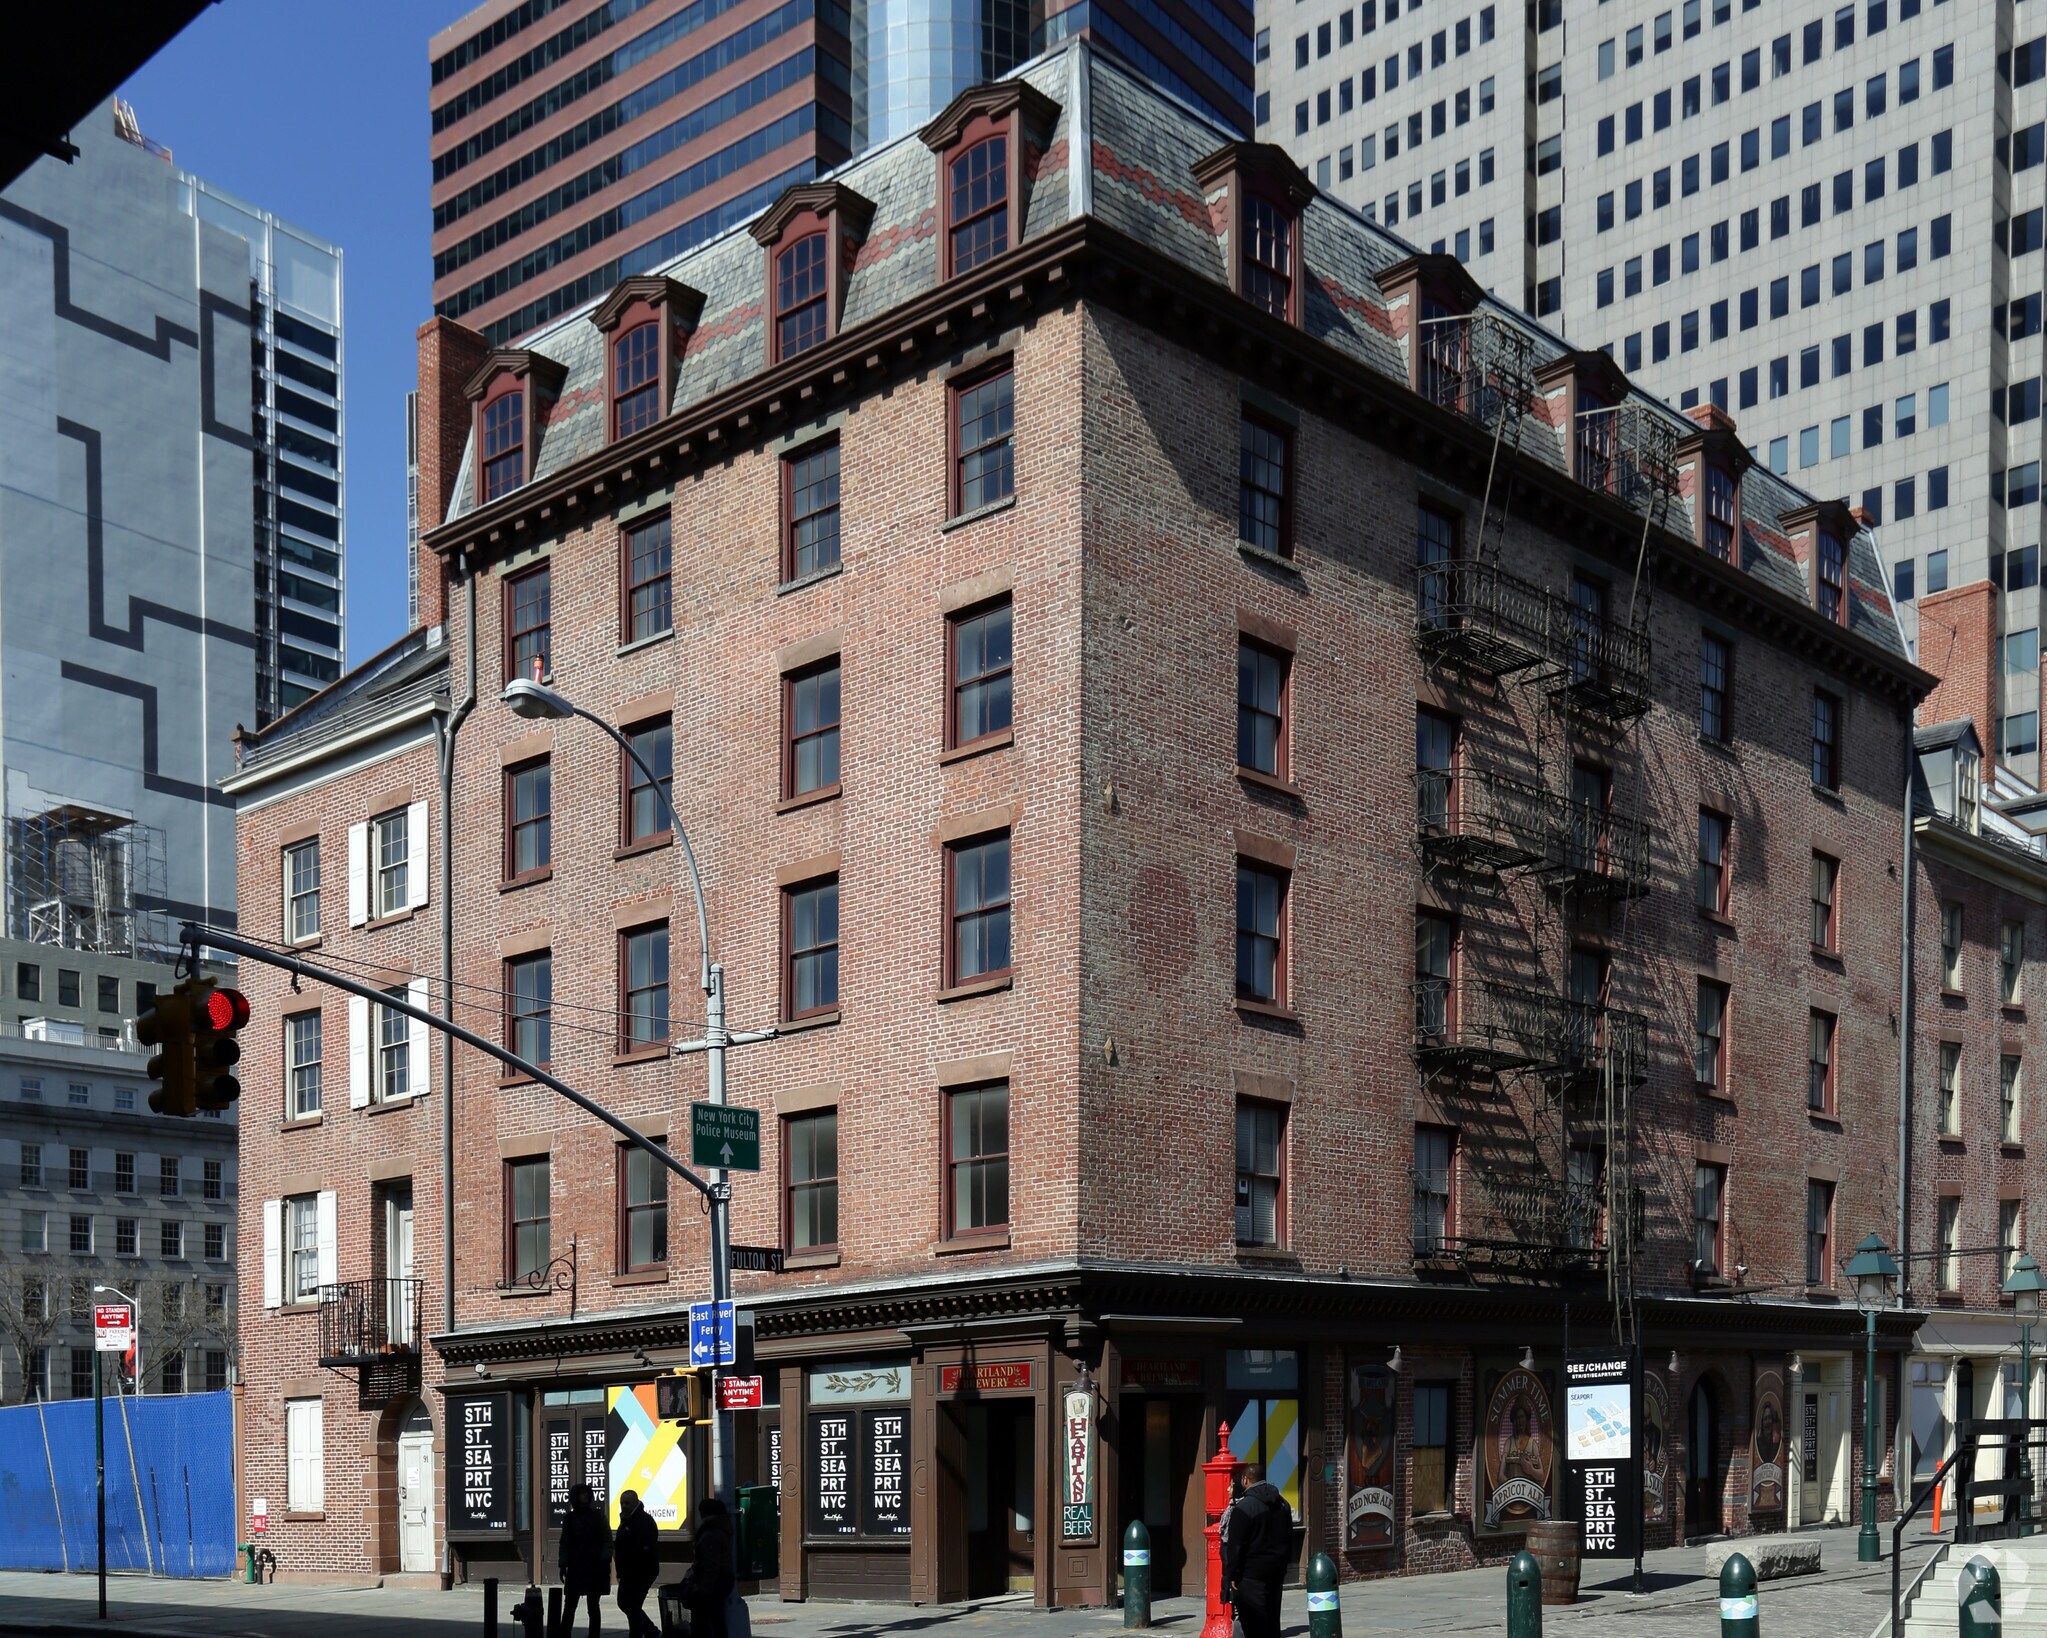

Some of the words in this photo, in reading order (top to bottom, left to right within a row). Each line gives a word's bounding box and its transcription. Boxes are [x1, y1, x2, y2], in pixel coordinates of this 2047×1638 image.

[698, 1108, 716, 1122] New
[718, 1110, 737, 1125] York
[738, 1112, 755, 1130] City
[695, 1123, 721, 1138] Police
[723, 1126, 757, 1142] Museum
[731, 1251, 766, 1270] FULTON
[771, 1253, 782, 1271] ST
[691, 1310, 709, 1322] East
[712, 1307, 733, 1320] River
[701, 1325, 723, 1336] Ferry
[959, 1366, 1014, 1378] HEARTLAND
[1567, 1361, 1627, 1373] SEE/CHANGE
[717, 1380, 727, 1388] NO
[728, 1378, 759, 1388] STANDING
[723, 1387, 755, 1396] ANYTIME
[1571, 1393, 1594, 1401] SEAPORT
[1490, 1375, 1528, 1424] SUMMER
[1531, 1381, 1549, 1424] TIME
[465, 1407, 492, 1423] STH
[821, 1423, 846, 1437] STH
[874, 1421, 901, 1435] STH
[1805, 1429, 1816, 1437] SEA
[465, 1429, 489, 1444] ST.
[551, 1436, 569, 1447] STH
[585, 1433, 605, 1444] STH
[821, 1442, 844, 1455] ST.
[874, 1440, 899, 1453] ST.
[1805, 1441, 1816, 1449] PRT
[465, 1450, 492, 1465] SEA
[551, 1450, 567, 1461] ST.
[585, 1448, 603, 1459] ST.
[1805, 1452, 1816, 1460] NYC
[821, 1460, 846, 1472] SEA
[874, 1458, 901, 1471] SEA
[1070, 1418, 1087, 1503] HEARTLAND
[551, 1464, 569, 1475] SEA
[586, 1462, 605, 1473] SEA
[465, 1471, 492, 1486] PRT
[551, 1478, 569, 1489] PRT
[586, 1476, 605, 1487] PRT
[874, 1477, 901, 1490] PRT
[1585, 1472, 1615, 1484] STH
[821, 1478, 846, 1491] PRT
[551, 1492, 569, 1503] NYC
[593, 1491, 605, 1501] YC
[1494, 1484, 1527, 1508] APRICOT
[1527, 1486, 1543, 1504] ALE
[1586, 1488, 1612, 1500] ST.
[466, 1493, 492, 1508] NYC
[821, 1496, 846, 1508] NYC
[874, 1495, 901, 1508] NYC
[1350, 1497, 1363, 1513] RED
[1363, 1492, 1380, 1506] NOSE
[1380, 1494, 1393, 1510] ALE
[1063, 1505, 1092, 1520] REAL
[1586, 1505, 1615, 1517] SEA
[1064, 1520, 1092, 1536] BEER
[1586, 1521, 1615, 1533] PRT
[1586, 1538, 1616, 1550] NYC
